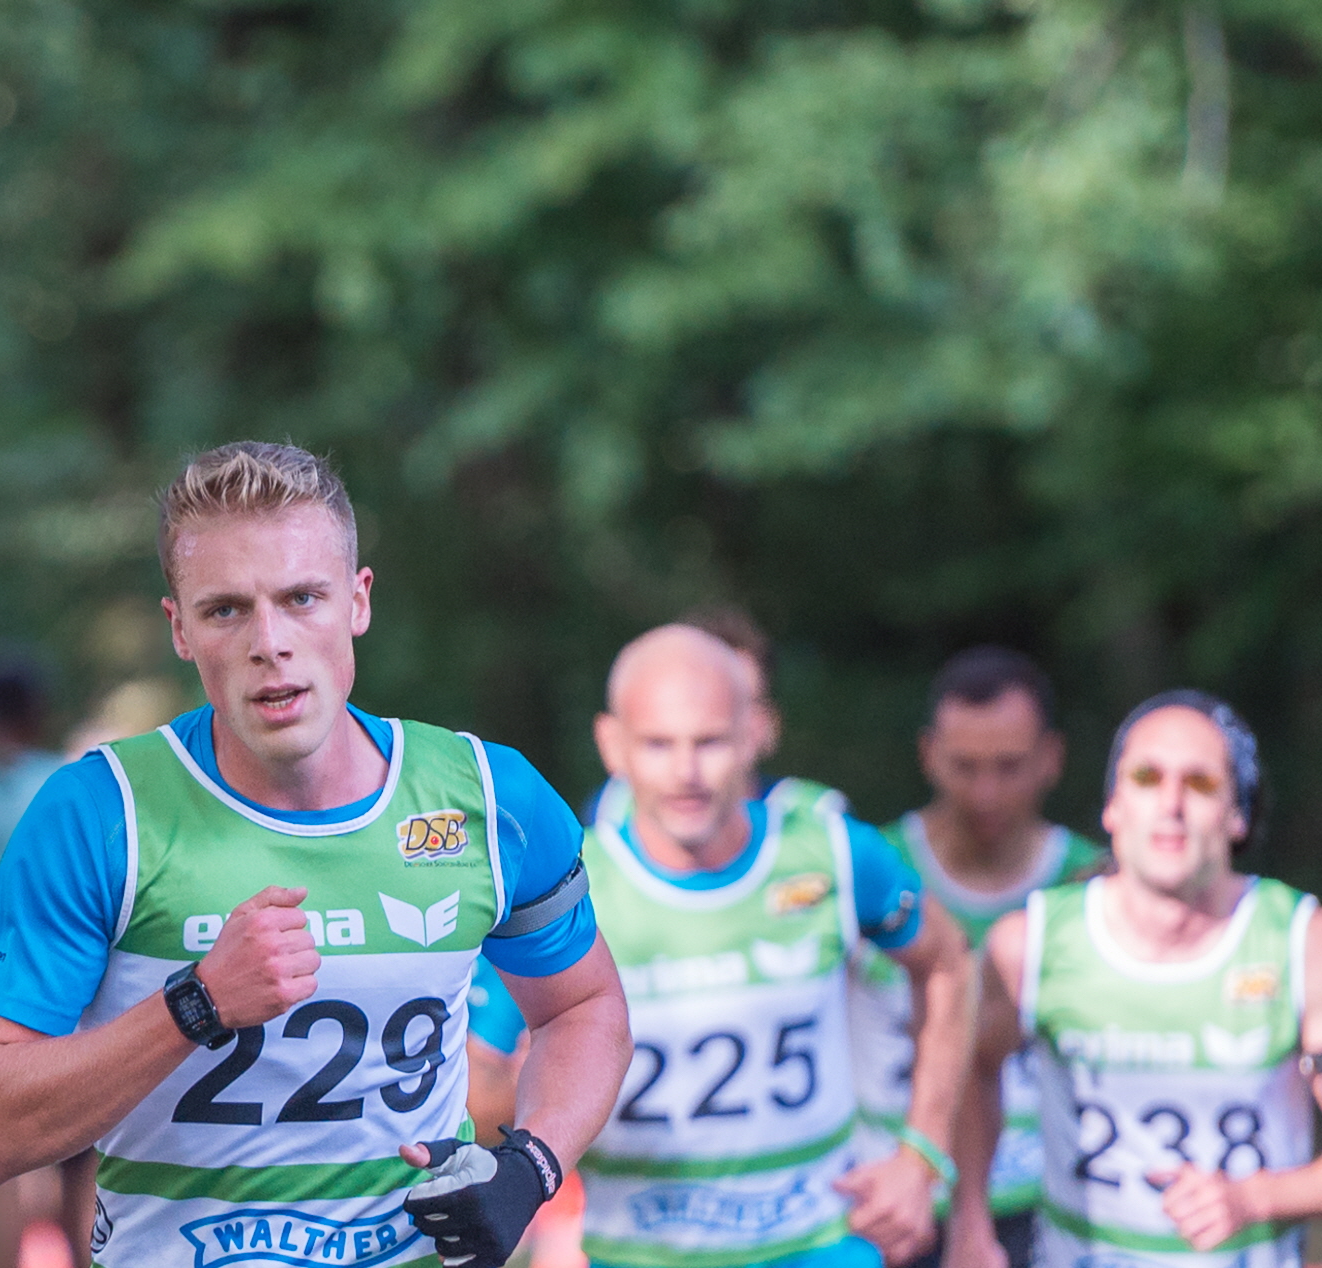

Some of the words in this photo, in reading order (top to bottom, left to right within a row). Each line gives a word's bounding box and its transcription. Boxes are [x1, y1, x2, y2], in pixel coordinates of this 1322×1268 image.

[405, 817, 461, 851] DSB
[171, 996, 451, 1126] 229
[618, 1016, 818, 1124] 225
[1072, 1102, 1267, 1193] 238
[213, 1218, 399, 1261] WALTHER
